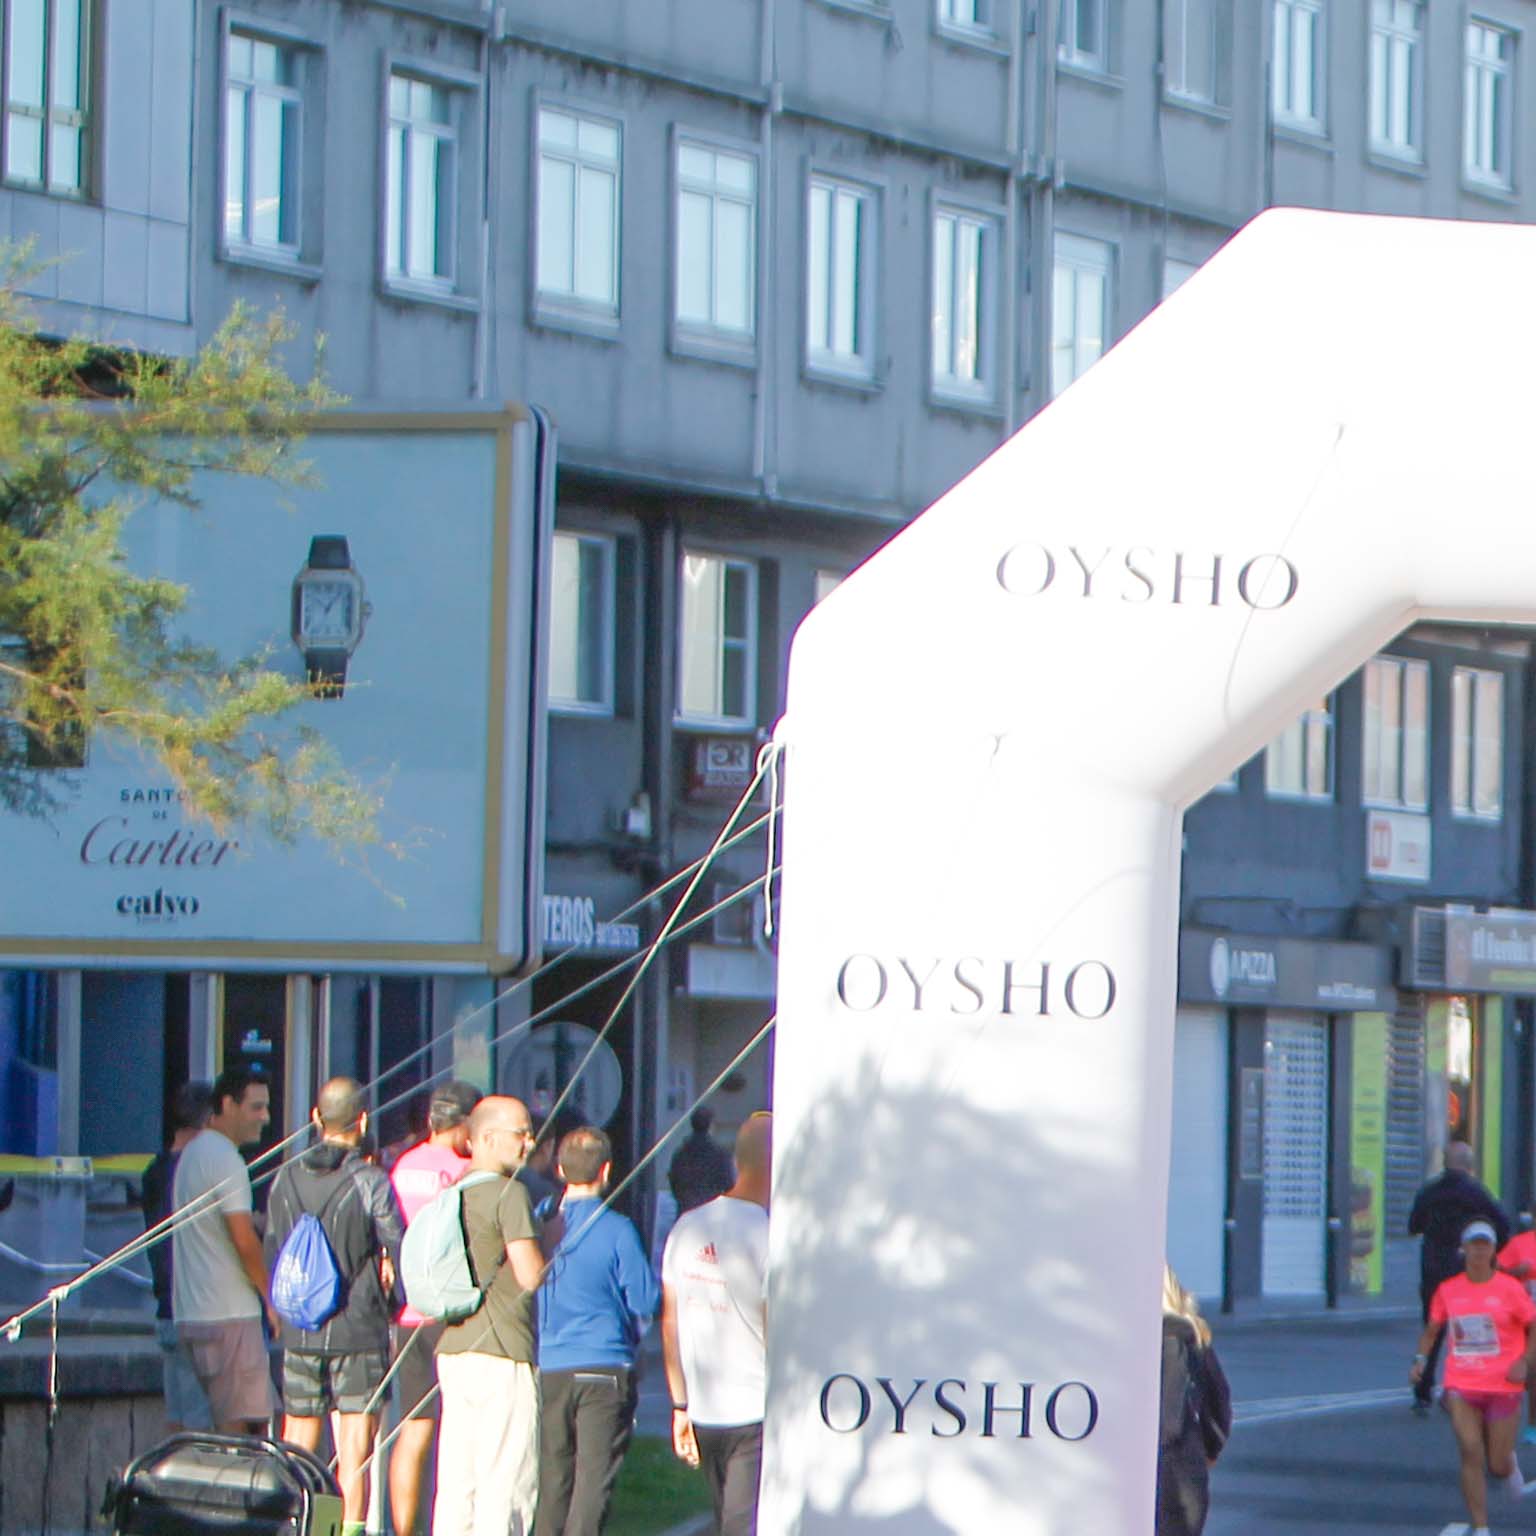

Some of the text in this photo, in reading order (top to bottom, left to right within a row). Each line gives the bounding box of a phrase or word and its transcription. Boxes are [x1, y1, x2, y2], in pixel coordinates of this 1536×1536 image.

[996, 541, 1298, 611] OYSHO
[80, 815, 239, 865] Cartier
[116, 886, 200, 915] calvo
[837, 953, 1116, 1020] OYSHO
[819, 1373, 1099, 1442] OYSHO
